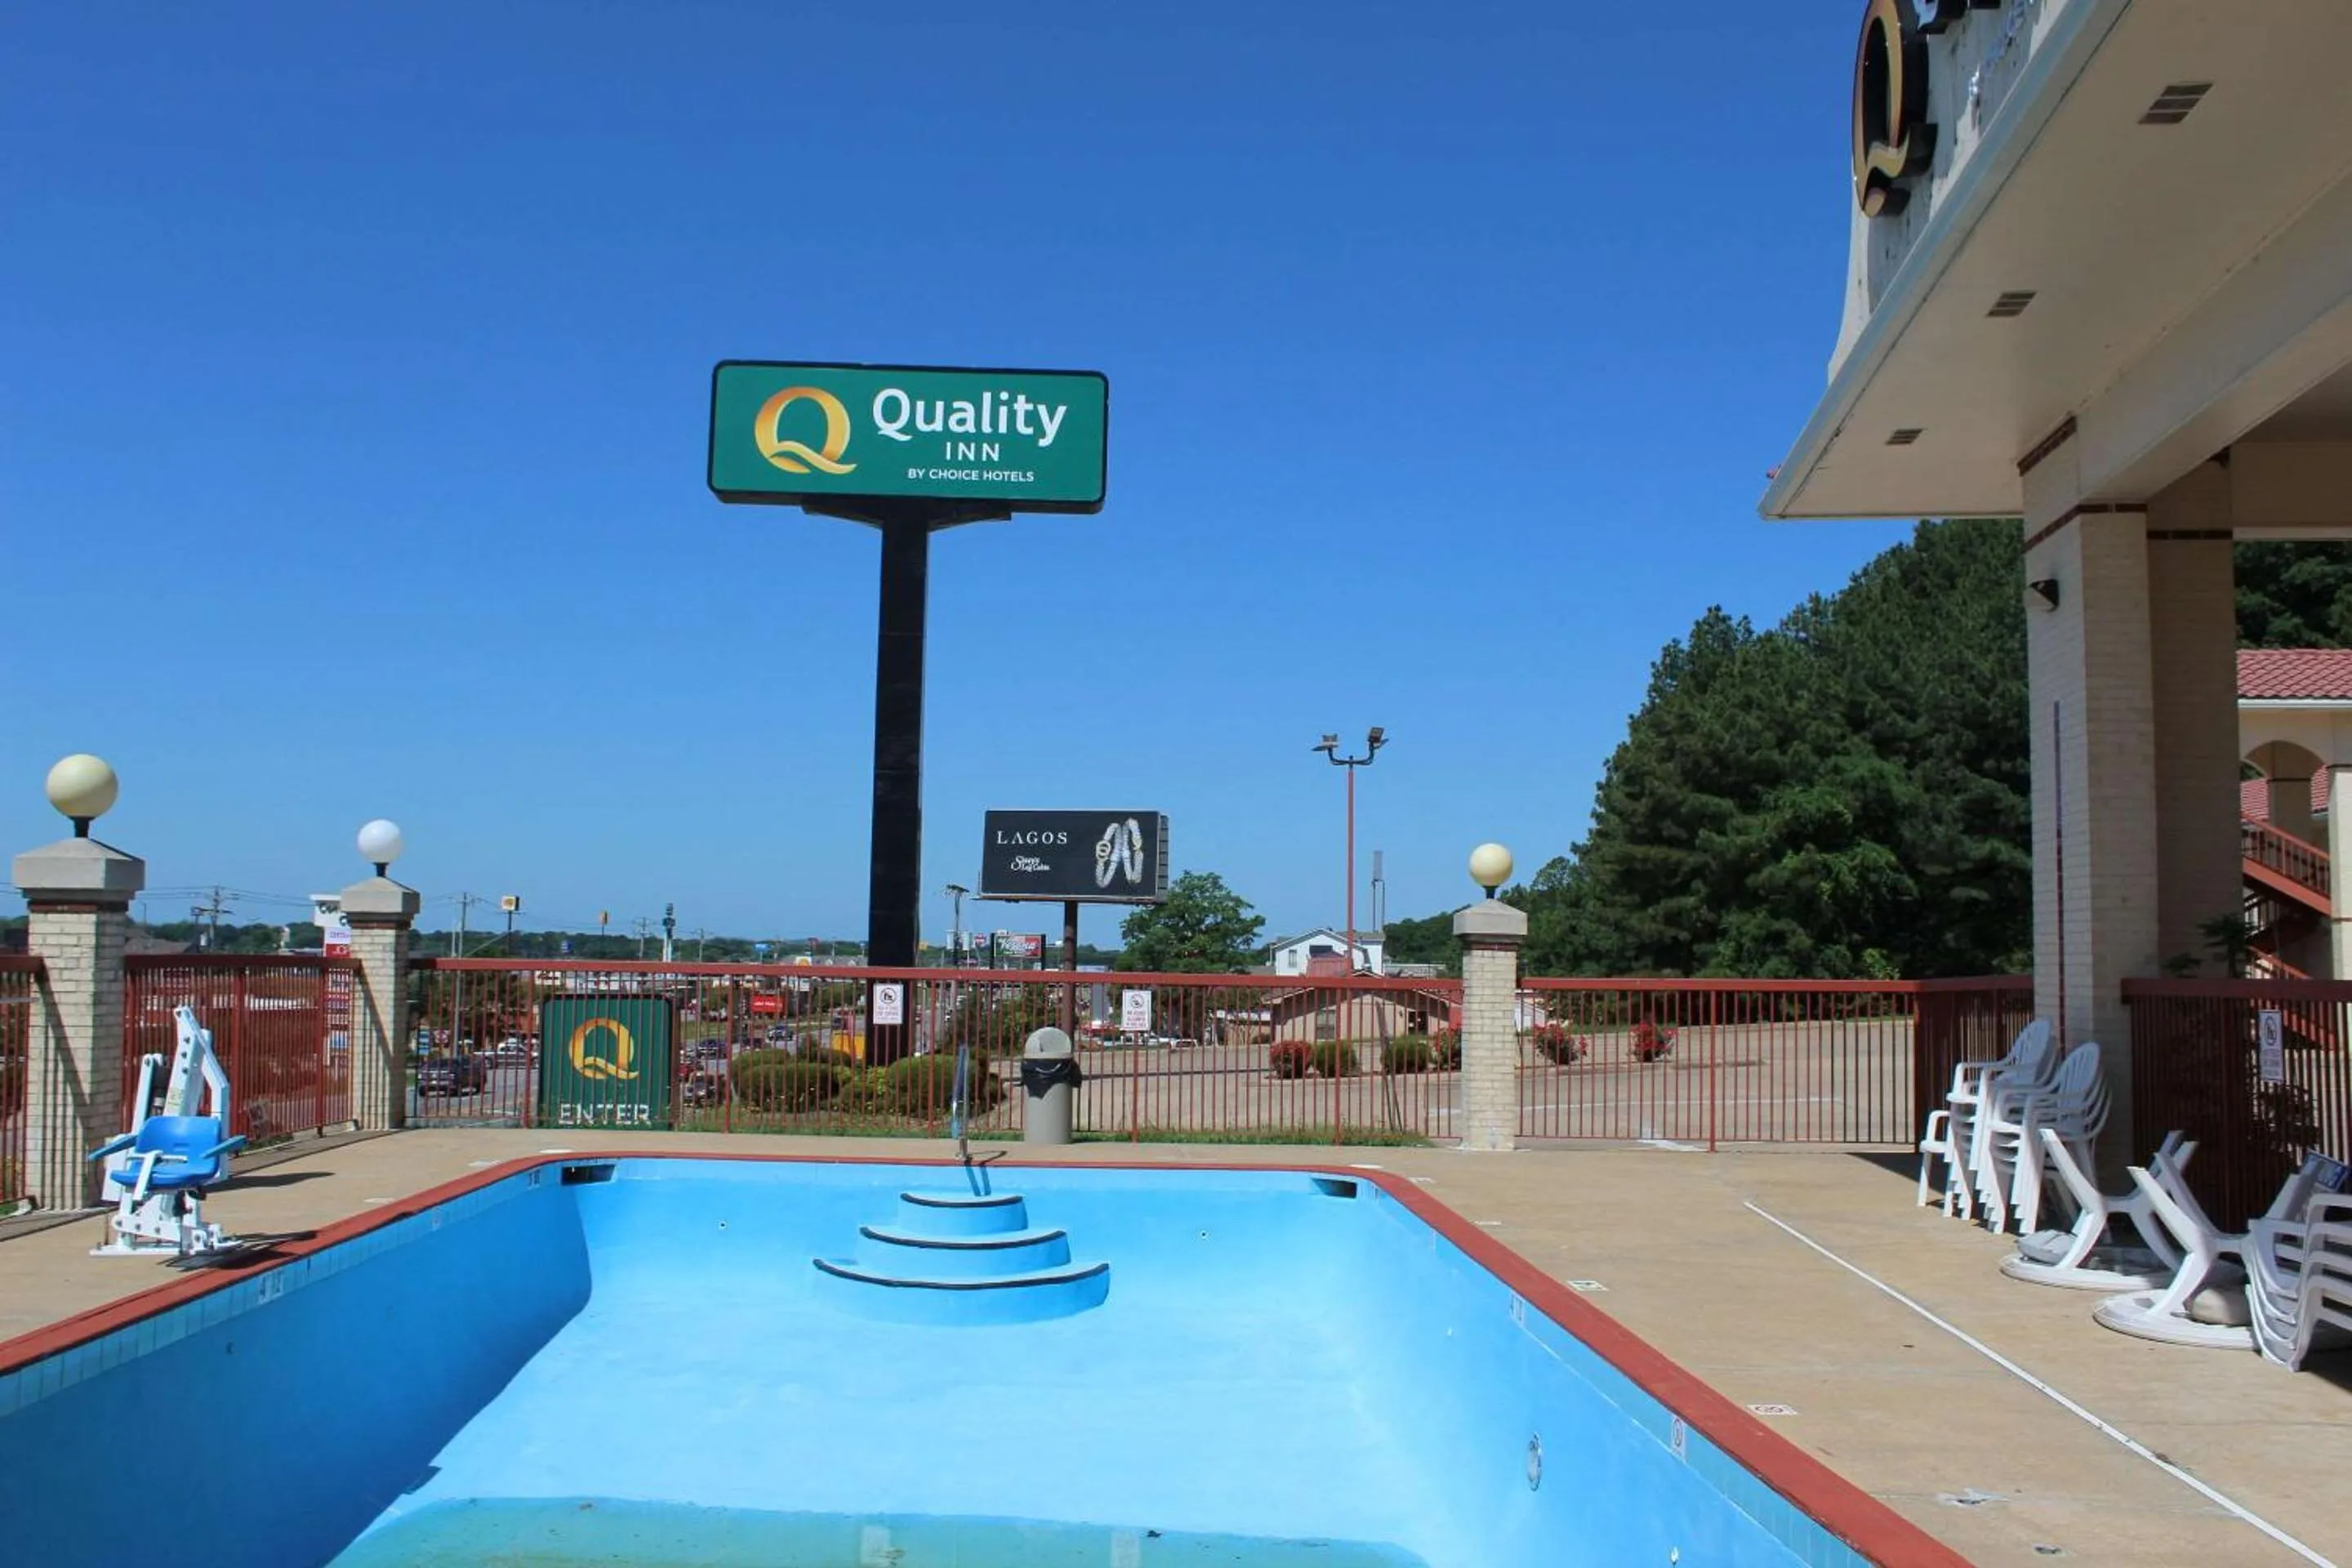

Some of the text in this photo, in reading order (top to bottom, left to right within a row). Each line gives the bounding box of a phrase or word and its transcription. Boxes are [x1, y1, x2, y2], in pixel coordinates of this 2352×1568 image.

[872, 387, 1068, 448] Quality
[754, 385, 858, 475] Q
[946, 441, 1000, 462] INN
[907, 468, 1035, 483] BY CHOICE HOTELS
[996, 830, 1068, 844] LAGOS
[558, 1102, 653, 1126] ENTER
